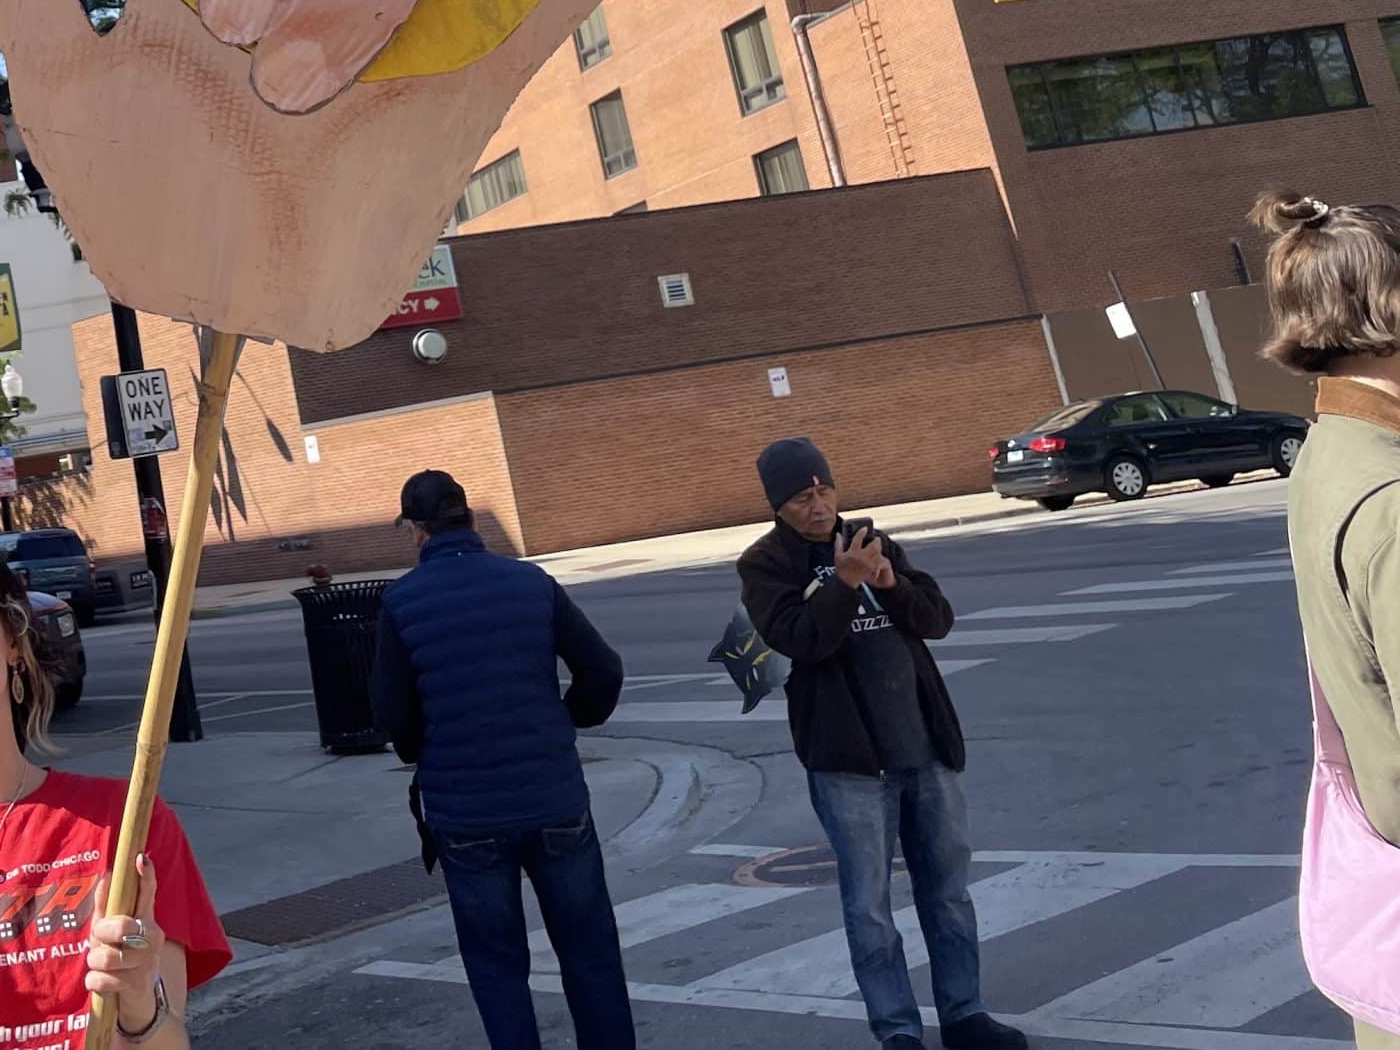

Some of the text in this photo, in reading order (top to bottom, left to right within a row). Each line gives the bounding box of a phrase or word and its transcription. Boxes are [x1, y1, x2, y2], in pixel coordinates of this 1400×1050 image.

[125, 376, 163, 398] ONE
[128, 399, 165, 422] WAY
[21, 863, 51, 874] TODO
[52, 850, 100, 868] CHICAGO
[50, 939, 91, 959] ALLIA
[15, 1019, 65, 1042] your
